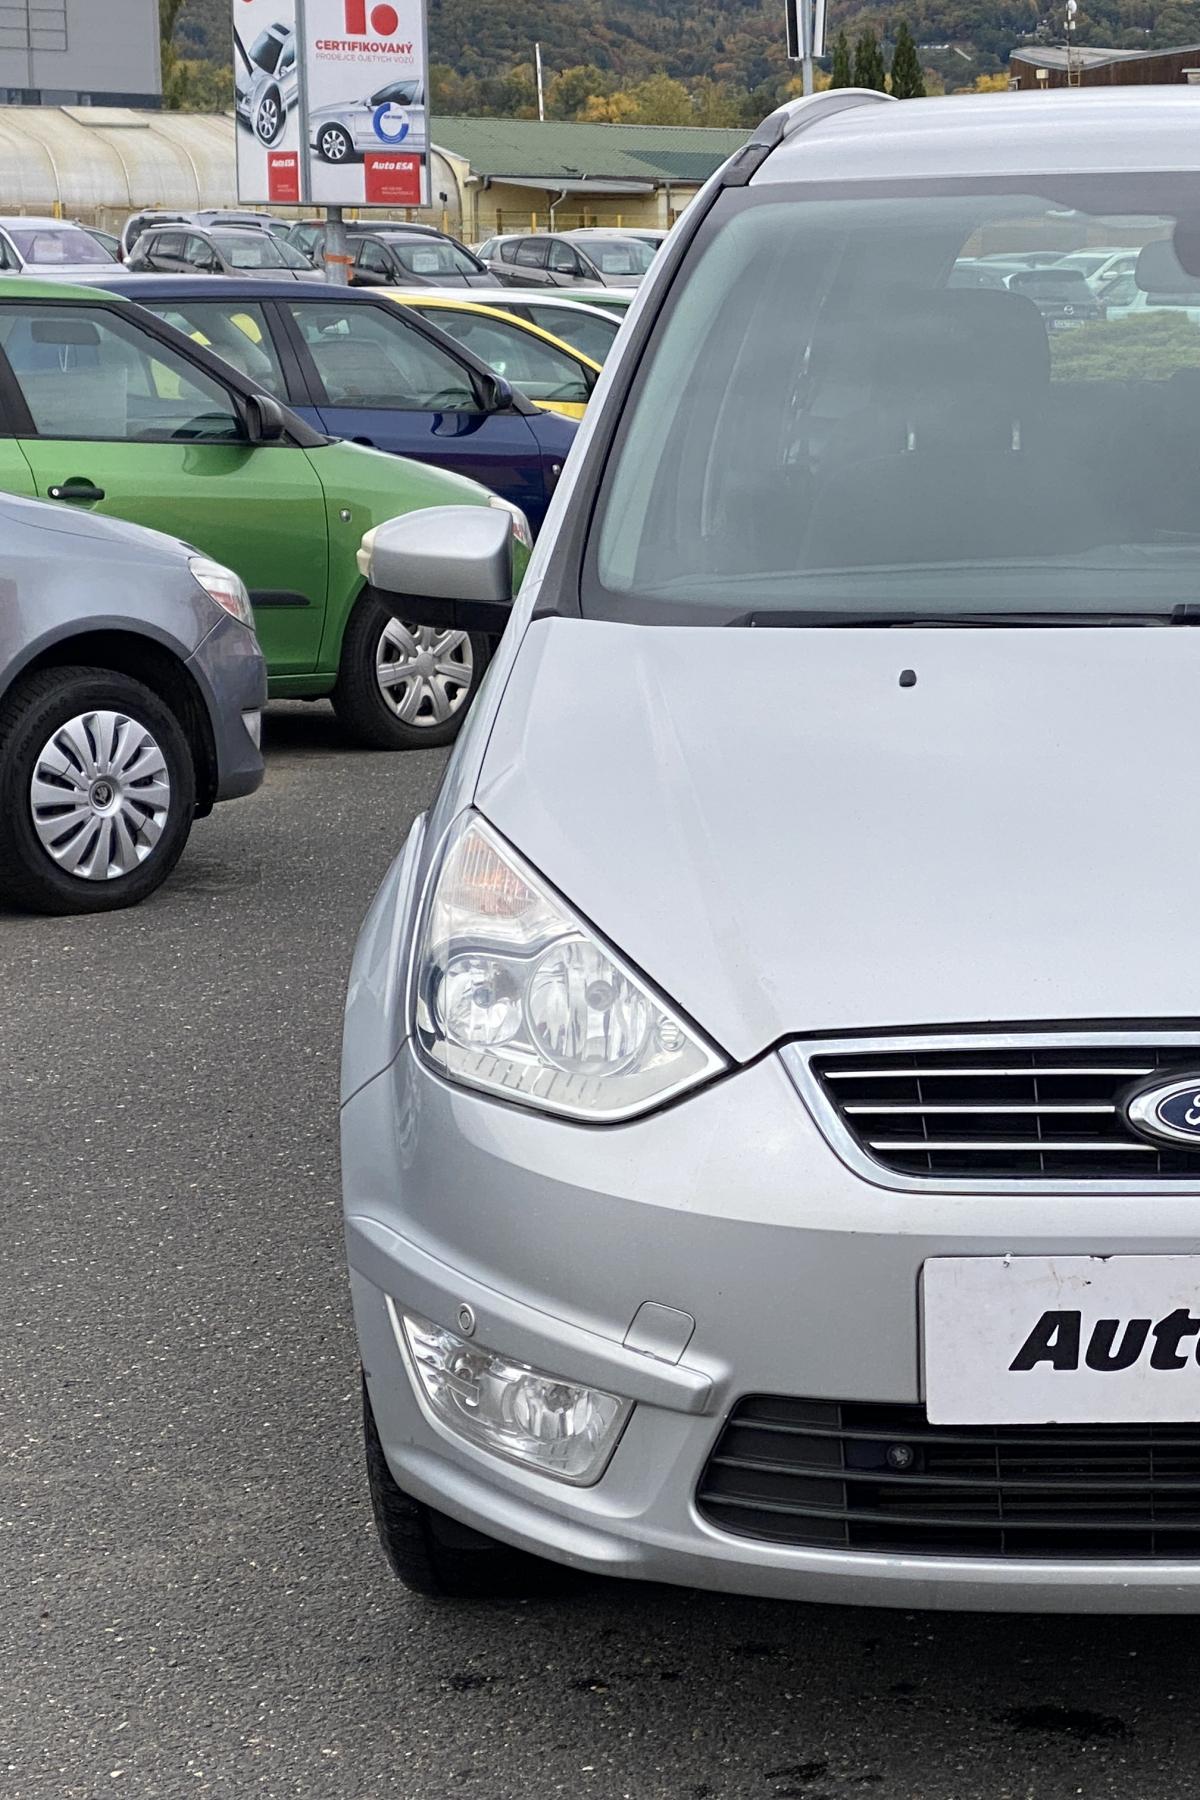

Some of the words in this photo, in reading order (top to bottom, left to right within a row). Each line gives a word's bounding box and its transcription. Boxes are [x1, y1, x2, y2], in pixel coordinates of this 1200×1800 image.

[315, 40, 413, 54] CERTIFIKOVANÝ
[315, 53, 356, 62] PRODEJCE
[372, 161, 395, 171] Auto
[396, 161, 413, 171] ESA
